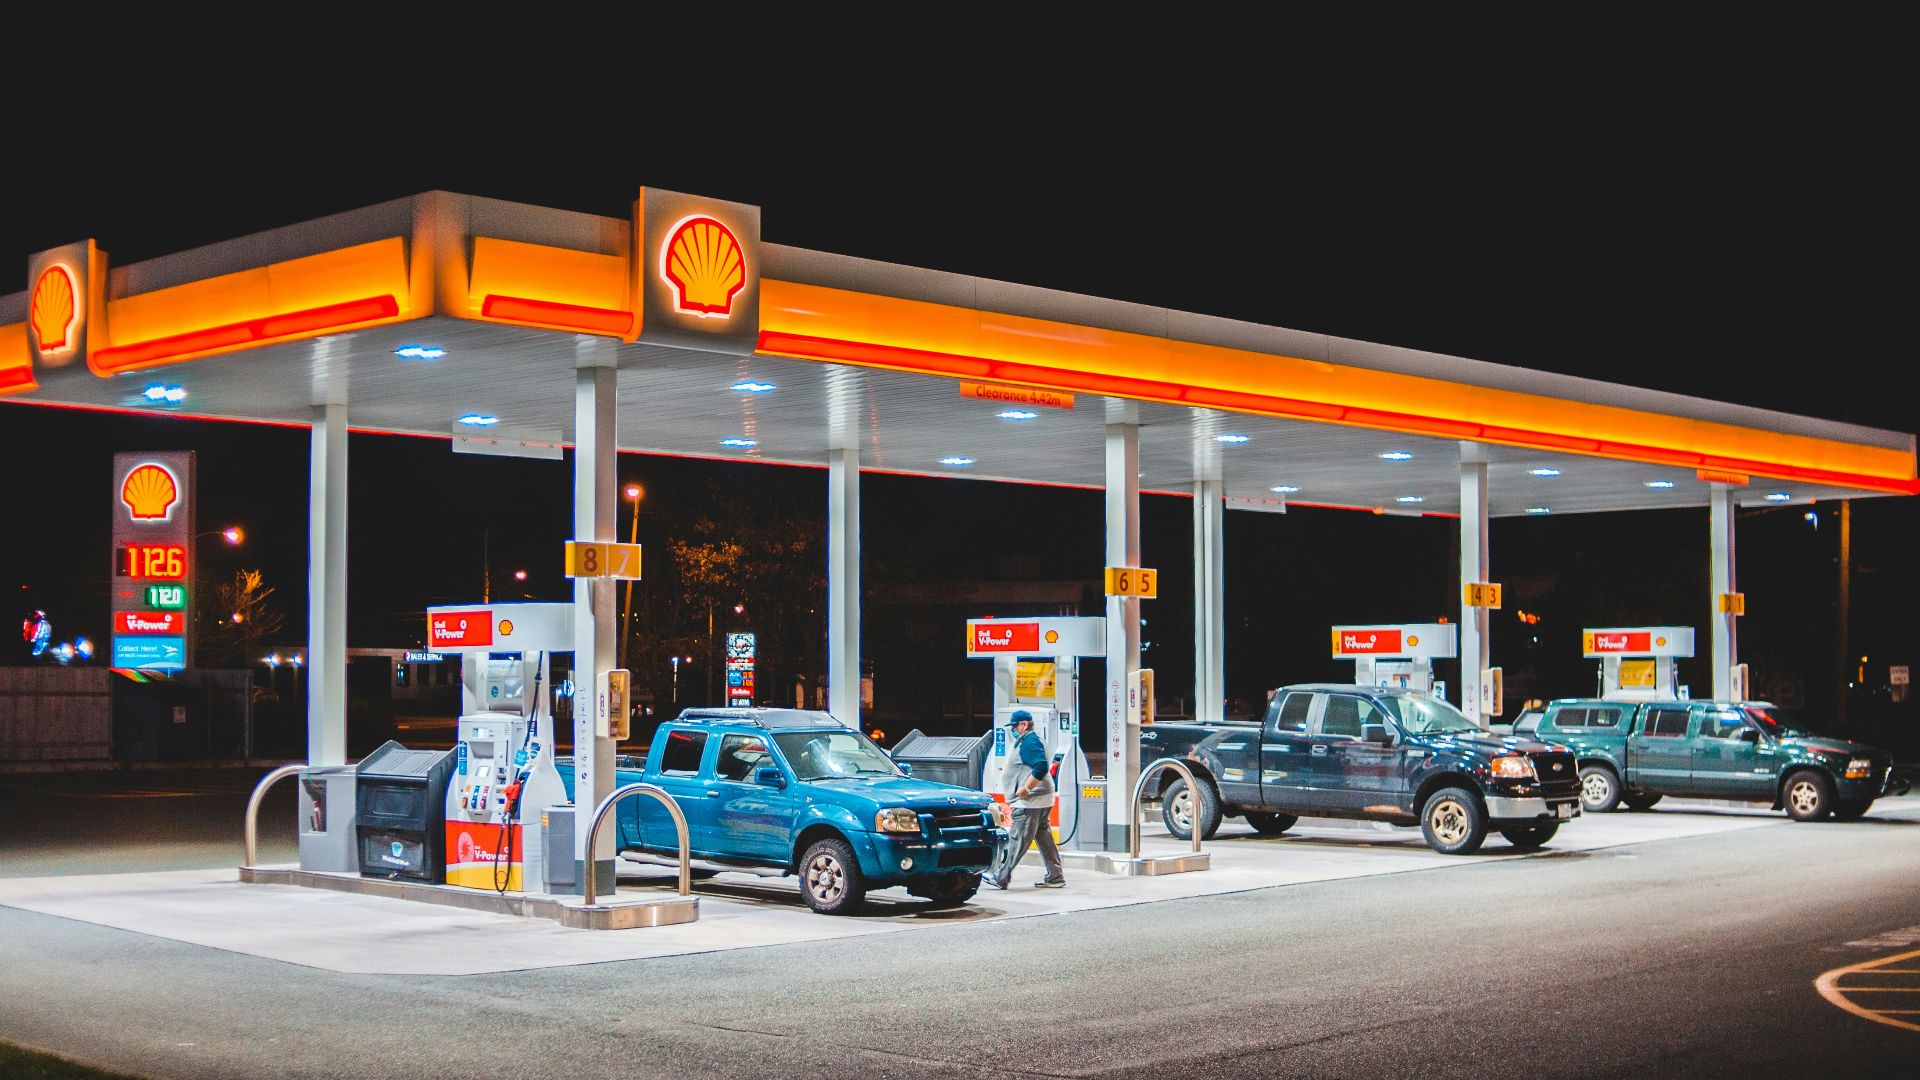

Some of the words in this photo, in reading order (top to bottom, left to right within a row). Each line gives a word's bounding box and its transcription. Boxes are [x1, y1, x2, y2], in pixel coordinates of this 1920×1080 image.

[976, 385, 1027, 402] Clearance
[1029, 391, 1060, 406] 4.42m
[128, 547, 185, 577] 112.6
[583, 547, 598, 572] 8
[616, 549, 631, 576] 7
[1119, 571, 1129, 592] 6
[1140, 573, 1150, 593] 5
[1475, 587, 1482, 605] 4
[1489, 587, 1496, 604] 3
[126, 619, 170, 630] V-Power
[434, 629, 465, 639] V-Power
[978, 637, 1010, 646] V-Power
[1344, 640, 1375, 649] V-Power
[474, 850, 508, 861] V-Power
